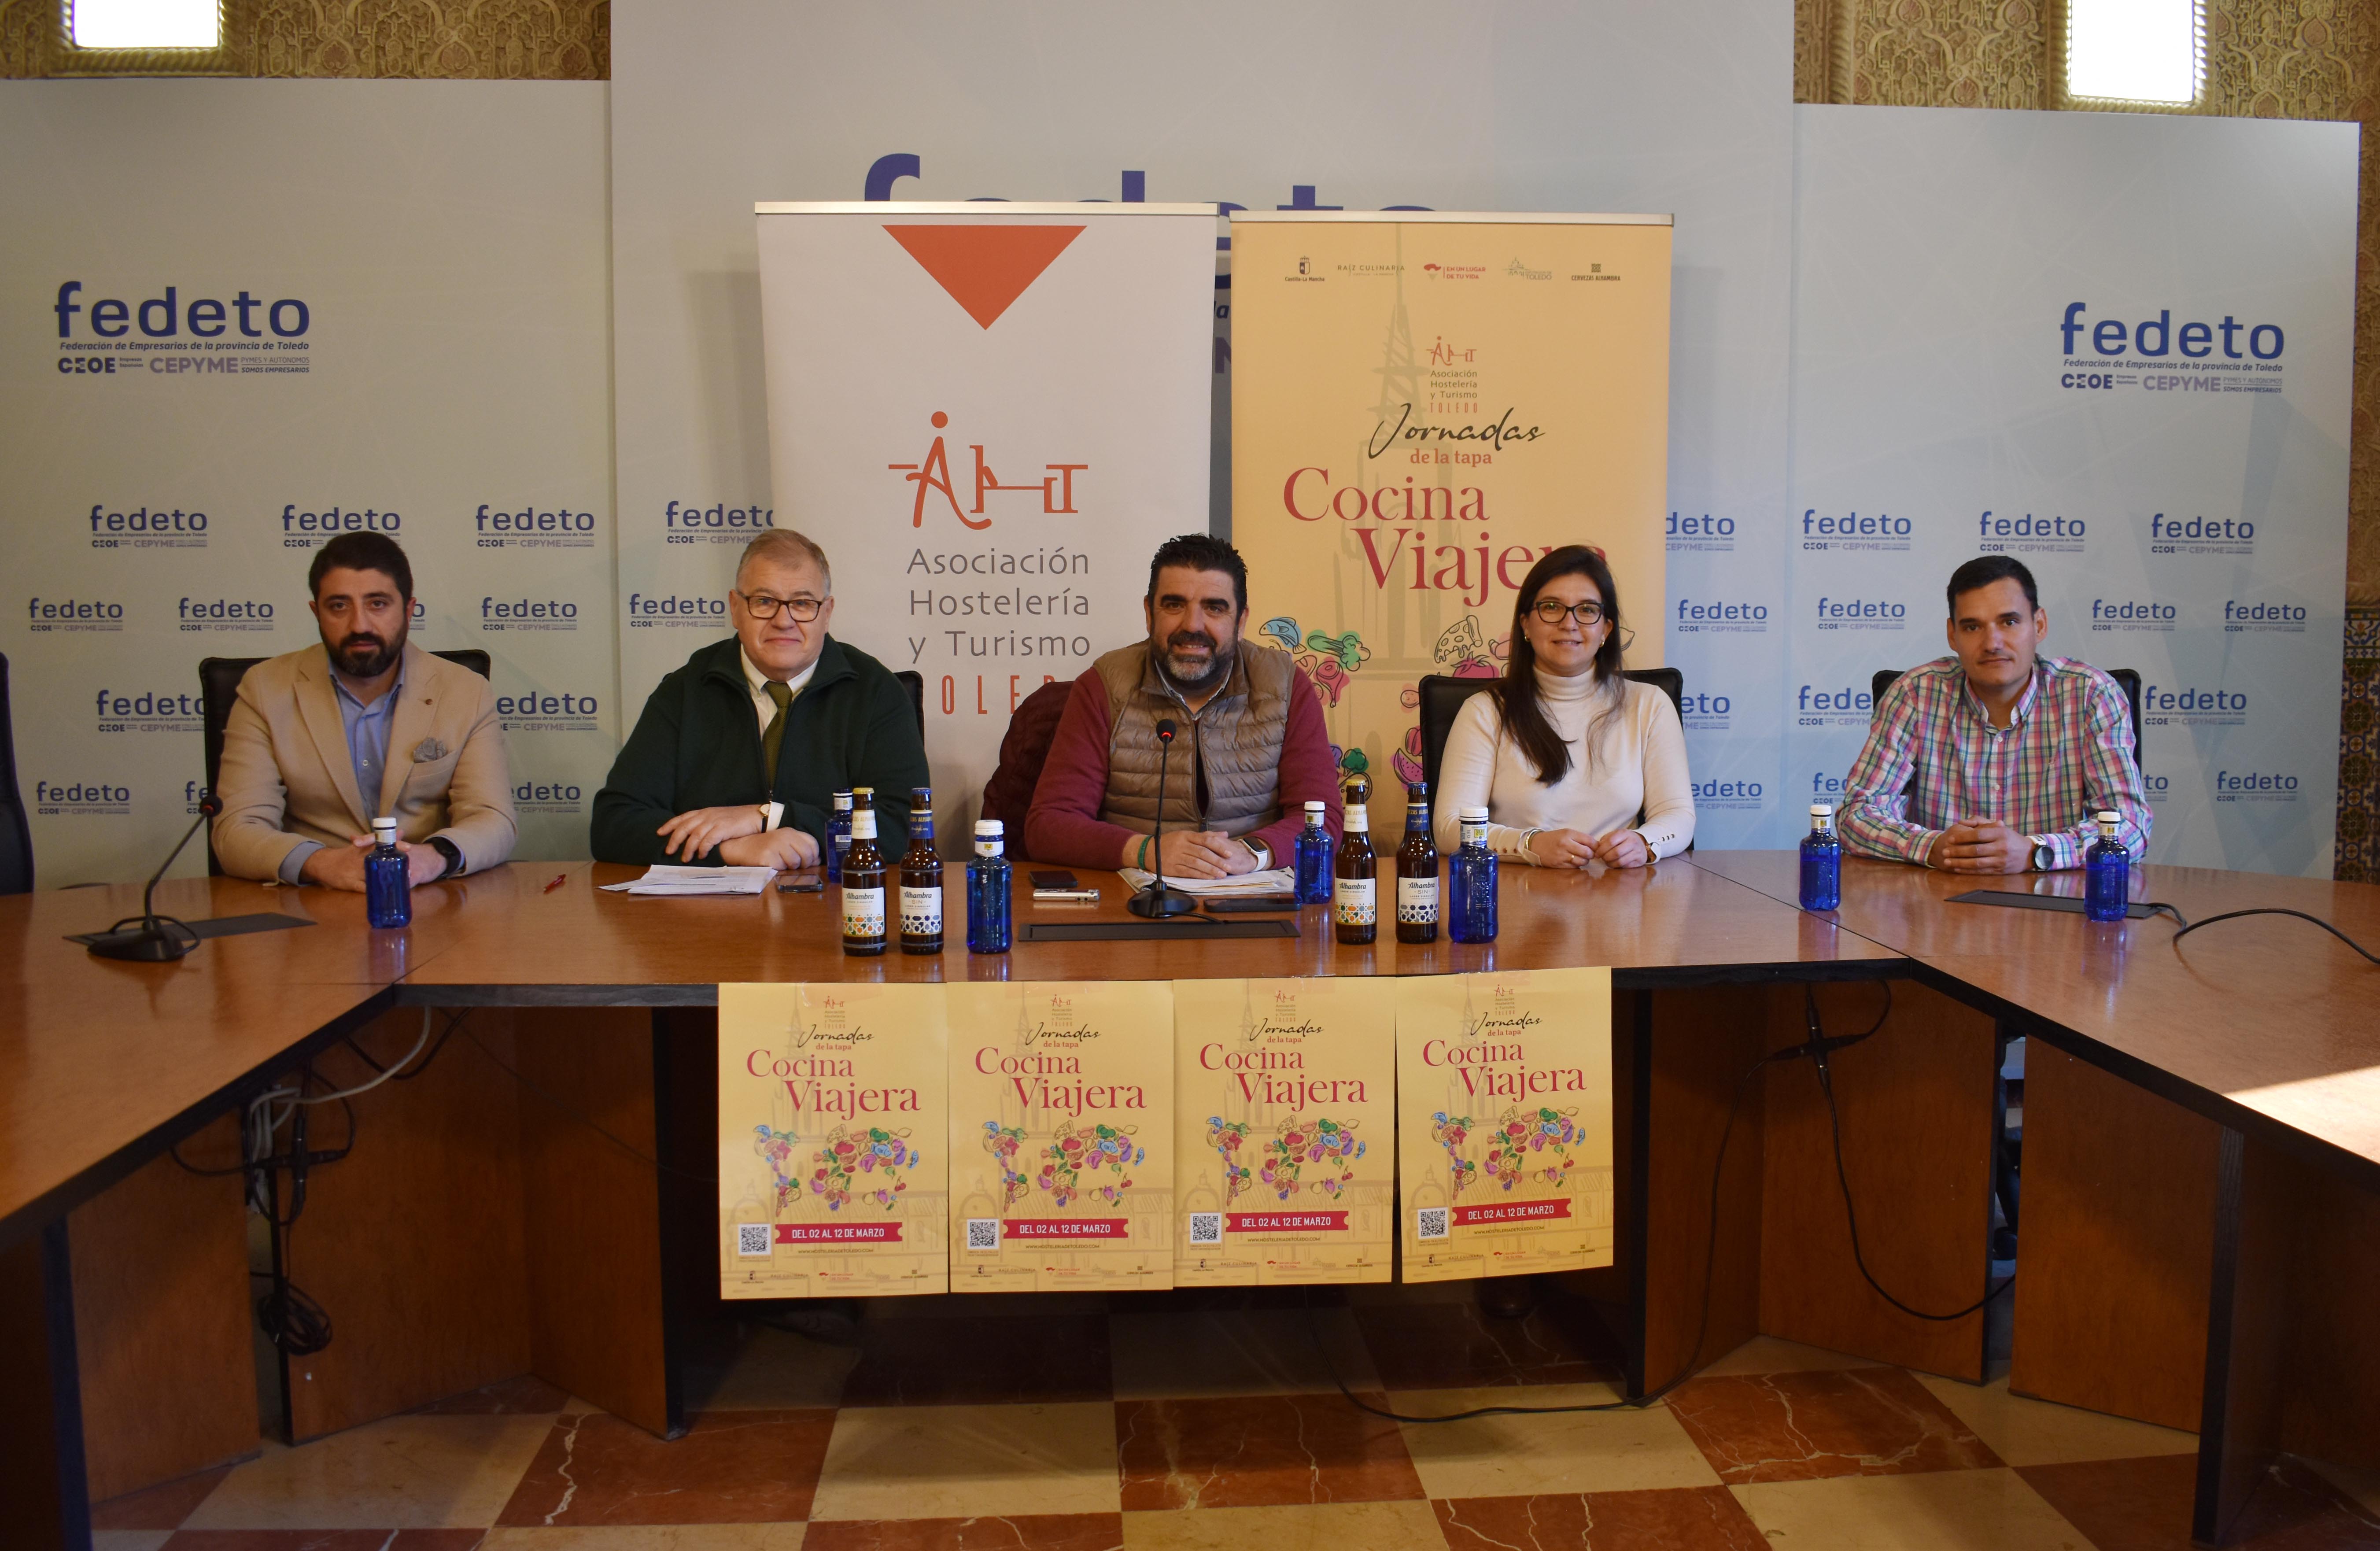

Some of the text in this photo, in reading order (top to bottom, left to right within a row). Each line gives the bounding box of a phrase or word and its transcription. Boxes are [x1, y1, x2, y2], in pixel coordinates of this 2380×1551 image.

[54, 281, 310, 338] fedeto
[2061, 302, 2284, 359] fedeto
[60, 342, 112, 351] Federación
[129, 342, 188, 351] Empresarios
[216, 342, 260, 351] provincia
[150, 358, 238, 373] CEPYME
[2063, 359, 2111, 368] Federación
[2126, 360, 2178, 371] Empresarios
[2201, 363, 2240, 372] provincia
[2242, 363, 2253, 372] de
[2255, 364, 2283, 372] Toledo
[2143, 376, 2221, 392] CEPYME
[1430, 402, 1478, 414] TOLEDO
[1368, 402, 1546, 459] Jornadas
[1410, 448, 1493, 467] de la tapa
[1284, 467, 1490, 521] Cocina
[90, 505, 207, 532] fedeto
[282, 505, 400, 531] fedeto
[476, 505, 594, 531] fedeto
[1803, 510, 1911, 535] fedeto
[1980, 511, 2085, 536] fedeto
[2152, 513, 2254, 539] fedeto
[907, 547, 1088, 575] Asociación
[1351, 528, 1606, 608] Viaje
[29, 598, 123, 619] fedeto
[179, 598, 273, 618] fedeto
[482, 597, 577, 618] fedeto
[630, 594, 725, 614] fedeto
[911, 588, 1089, 616] Hostelería
[1679, 599, 1767, 620] fedeto
[1818, 598, 1905, 617] fedeto
[2093, 599, 2176, 619] fedeto
[2225, 601, 2306, 620] fedeto
[908, 630, 1090, 664] y Turismo
[496, 691, 597, 715] edeto
[1798, 686, 1871, 710] fede
[2146, 686, 2247, 710] fedeto
[37, 781, 129, 802] fedeto
[2218, 771, 2298, 790] fedeto
[1025, 1022, 1101, 1045] Jornadas
[1249, 1018, 1325, 1041] Jornadas
[1470, 1012, 1543, 1035] Jornadas
[797, 1024, 875, 1048] Jornadas
[747, 1049, 855, 1078] Cocina
[975, 1047, 1081, 1074] Cocina
[1200, 1043, 1305, 1070] Cocina
[1423, 1039, 1524, 1067] Cocina
[1234, 1073, 1368, 1112] Viajera
[1457, 1065, 1587, 1103] Viajera
[784, 1080, 921, 1121] Viajera
[1010, 1077, 1147, 1117] Viajera
[1242, 1218, 1256, 1227] DEL
[1258, 1218, 1268, 1226] 02
[1283, 1218, 1291, 1226] 12
[1292, 1218, 1302, 1226] DE
[1304, 1217, 1331, 1226] MARZO
[1468, 1205, 1554, 1220] DEL 02 AL 12 DE MARZO
[792, 1230, 807, 1238] DEL
[809, 1230, 819, 1238] 02
[834, 1229, 842, 1237] 12
[845, 1229, 854, 1237] DE
[856, 1229, 884, 1237] MARZO
[1020, 1225, 1034, 1233] DEL
[1037, 1225, 1047, 1233] 02
[1061, 1225, 1069, 1233] 12
[1071, 1225, 1081, 1233] DE
[1083, 1224, 1110, 1233] MARZO
